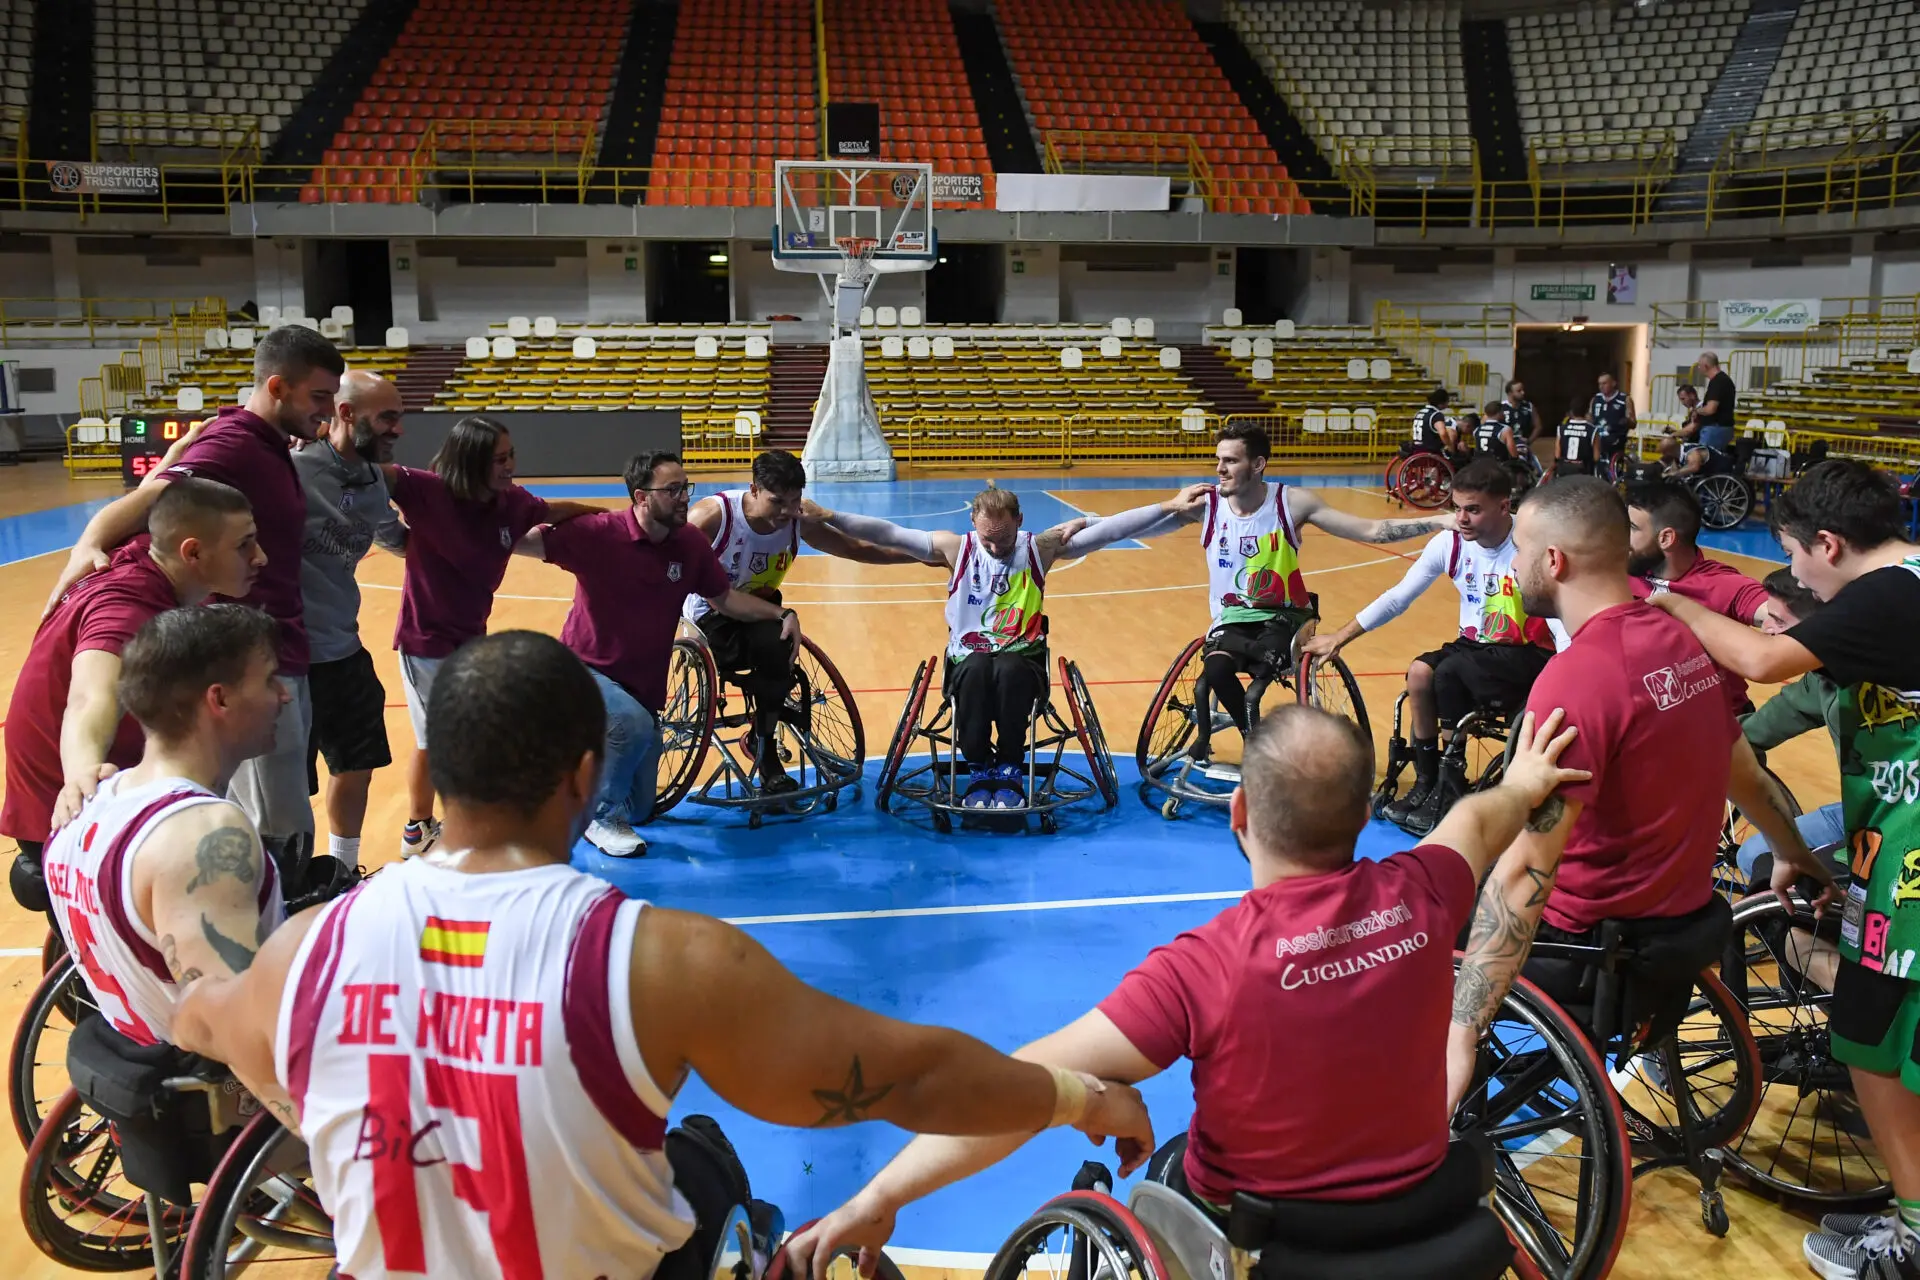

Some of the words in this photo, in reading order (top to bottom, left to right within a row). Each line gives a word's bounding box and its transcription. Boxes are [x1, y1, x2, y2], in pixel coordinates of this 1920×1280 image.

[83, 166, 159, 177] SUPPORTERS
[85, 176, 124, 187] TRUST
[124, 178, 159, 188] VIOLA
[931, 176, 982, 186] PPORTERS
[951, 186, 981, 196] VIOLA
[814, 215, 820, 225] 3
[1724, 306, 1768, 314] TOURING
[135, 420, 145, 435] 3
[124, 436, 146, 444] HOME
[1275, 898, 1413, 959] Assicurazioni
[1280, 931, 1430, 991] CUGLIANDRO
[337, 983, 400, 1046] DE
[416, 986, 544, 1067] HORTA
